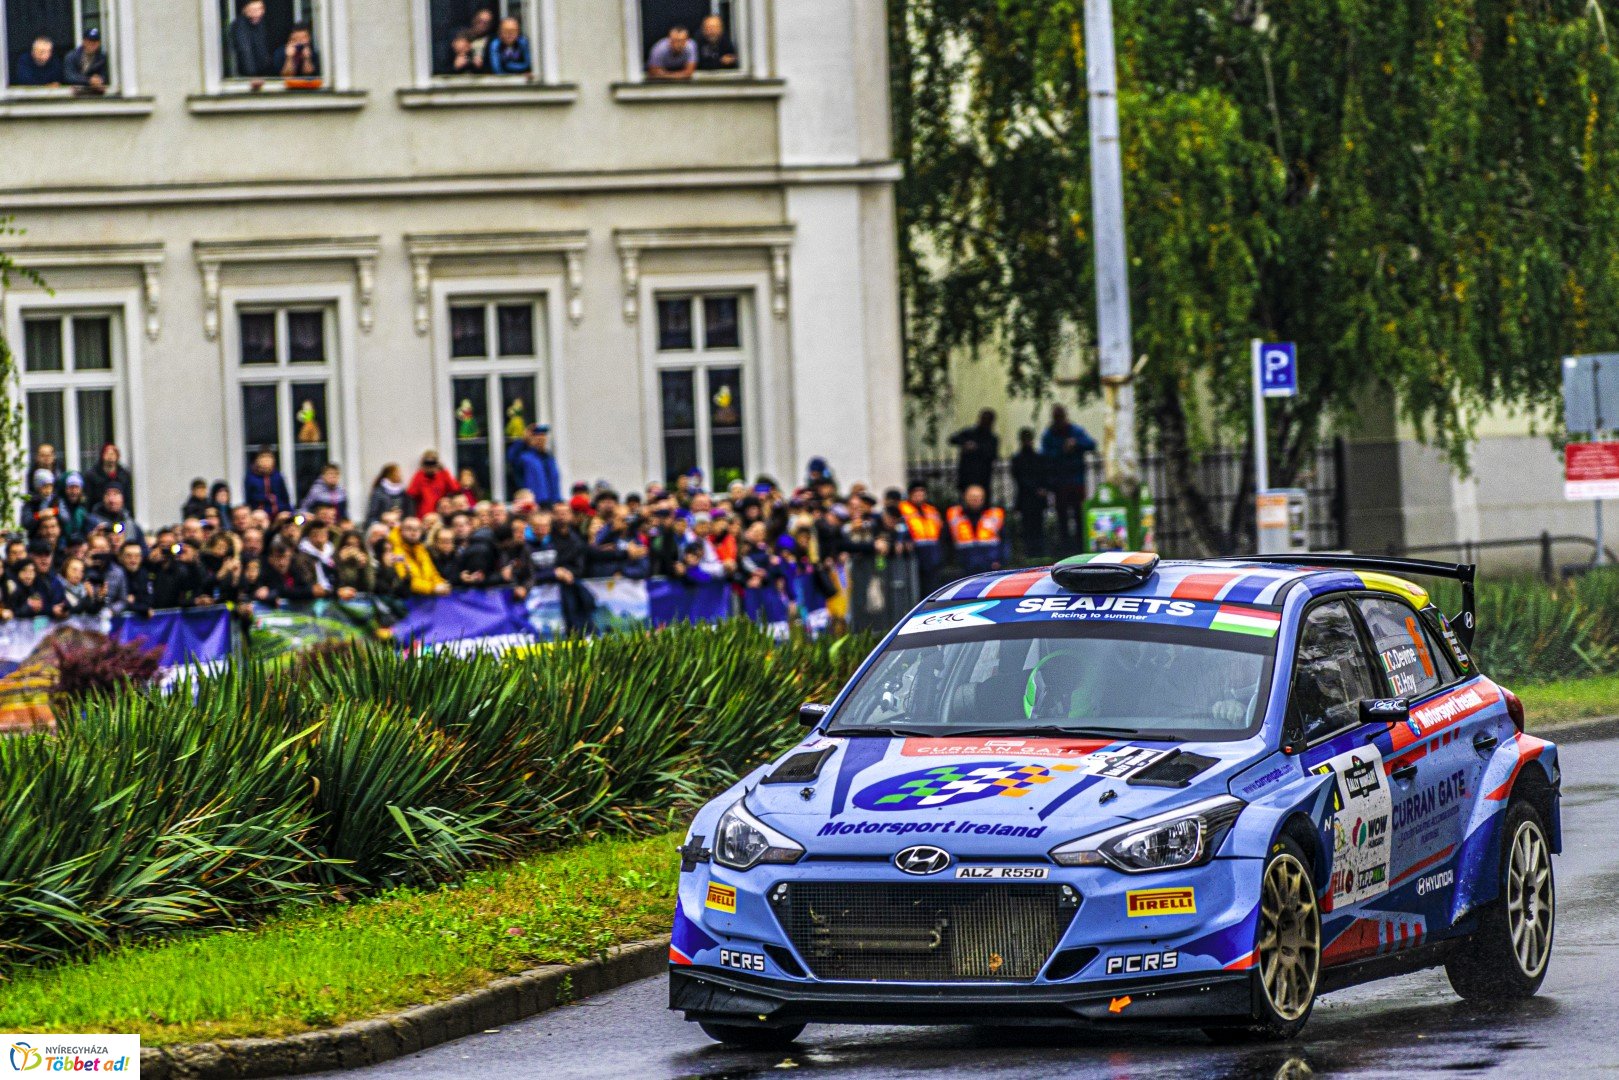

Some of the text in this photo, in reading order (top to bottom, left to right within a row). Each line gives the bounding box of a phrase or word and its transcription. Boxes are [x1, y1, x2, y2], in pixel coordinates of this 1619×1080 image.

[1015, 596, 1196, 617] SEAJETS
[1051, 612, 1087, 620] Racing
[1104, 613, 1148, 621] summer
[1414, 697, 1458, 729] Motorsport
[916, 745, 1011, 753] CURRAN
[1392, 785, 1435, 831] CURRAN
[1438, 769, 1466, 807] GATE
[817, 820, 1048, 839] Motorsport Ireland
[1368, 815, 1388, 838] WOW
[959, 867, 1045, 879] ALZ R550
[1425, 868, 1454, 893] HYUNDAI
[707, 885, 735, 907] PIRELLI
[1129, 891, 1193, 911] PIRELLI
[720, 949, 764, 971] PCRS
[1107, 951, 1178, 975] PCRS
